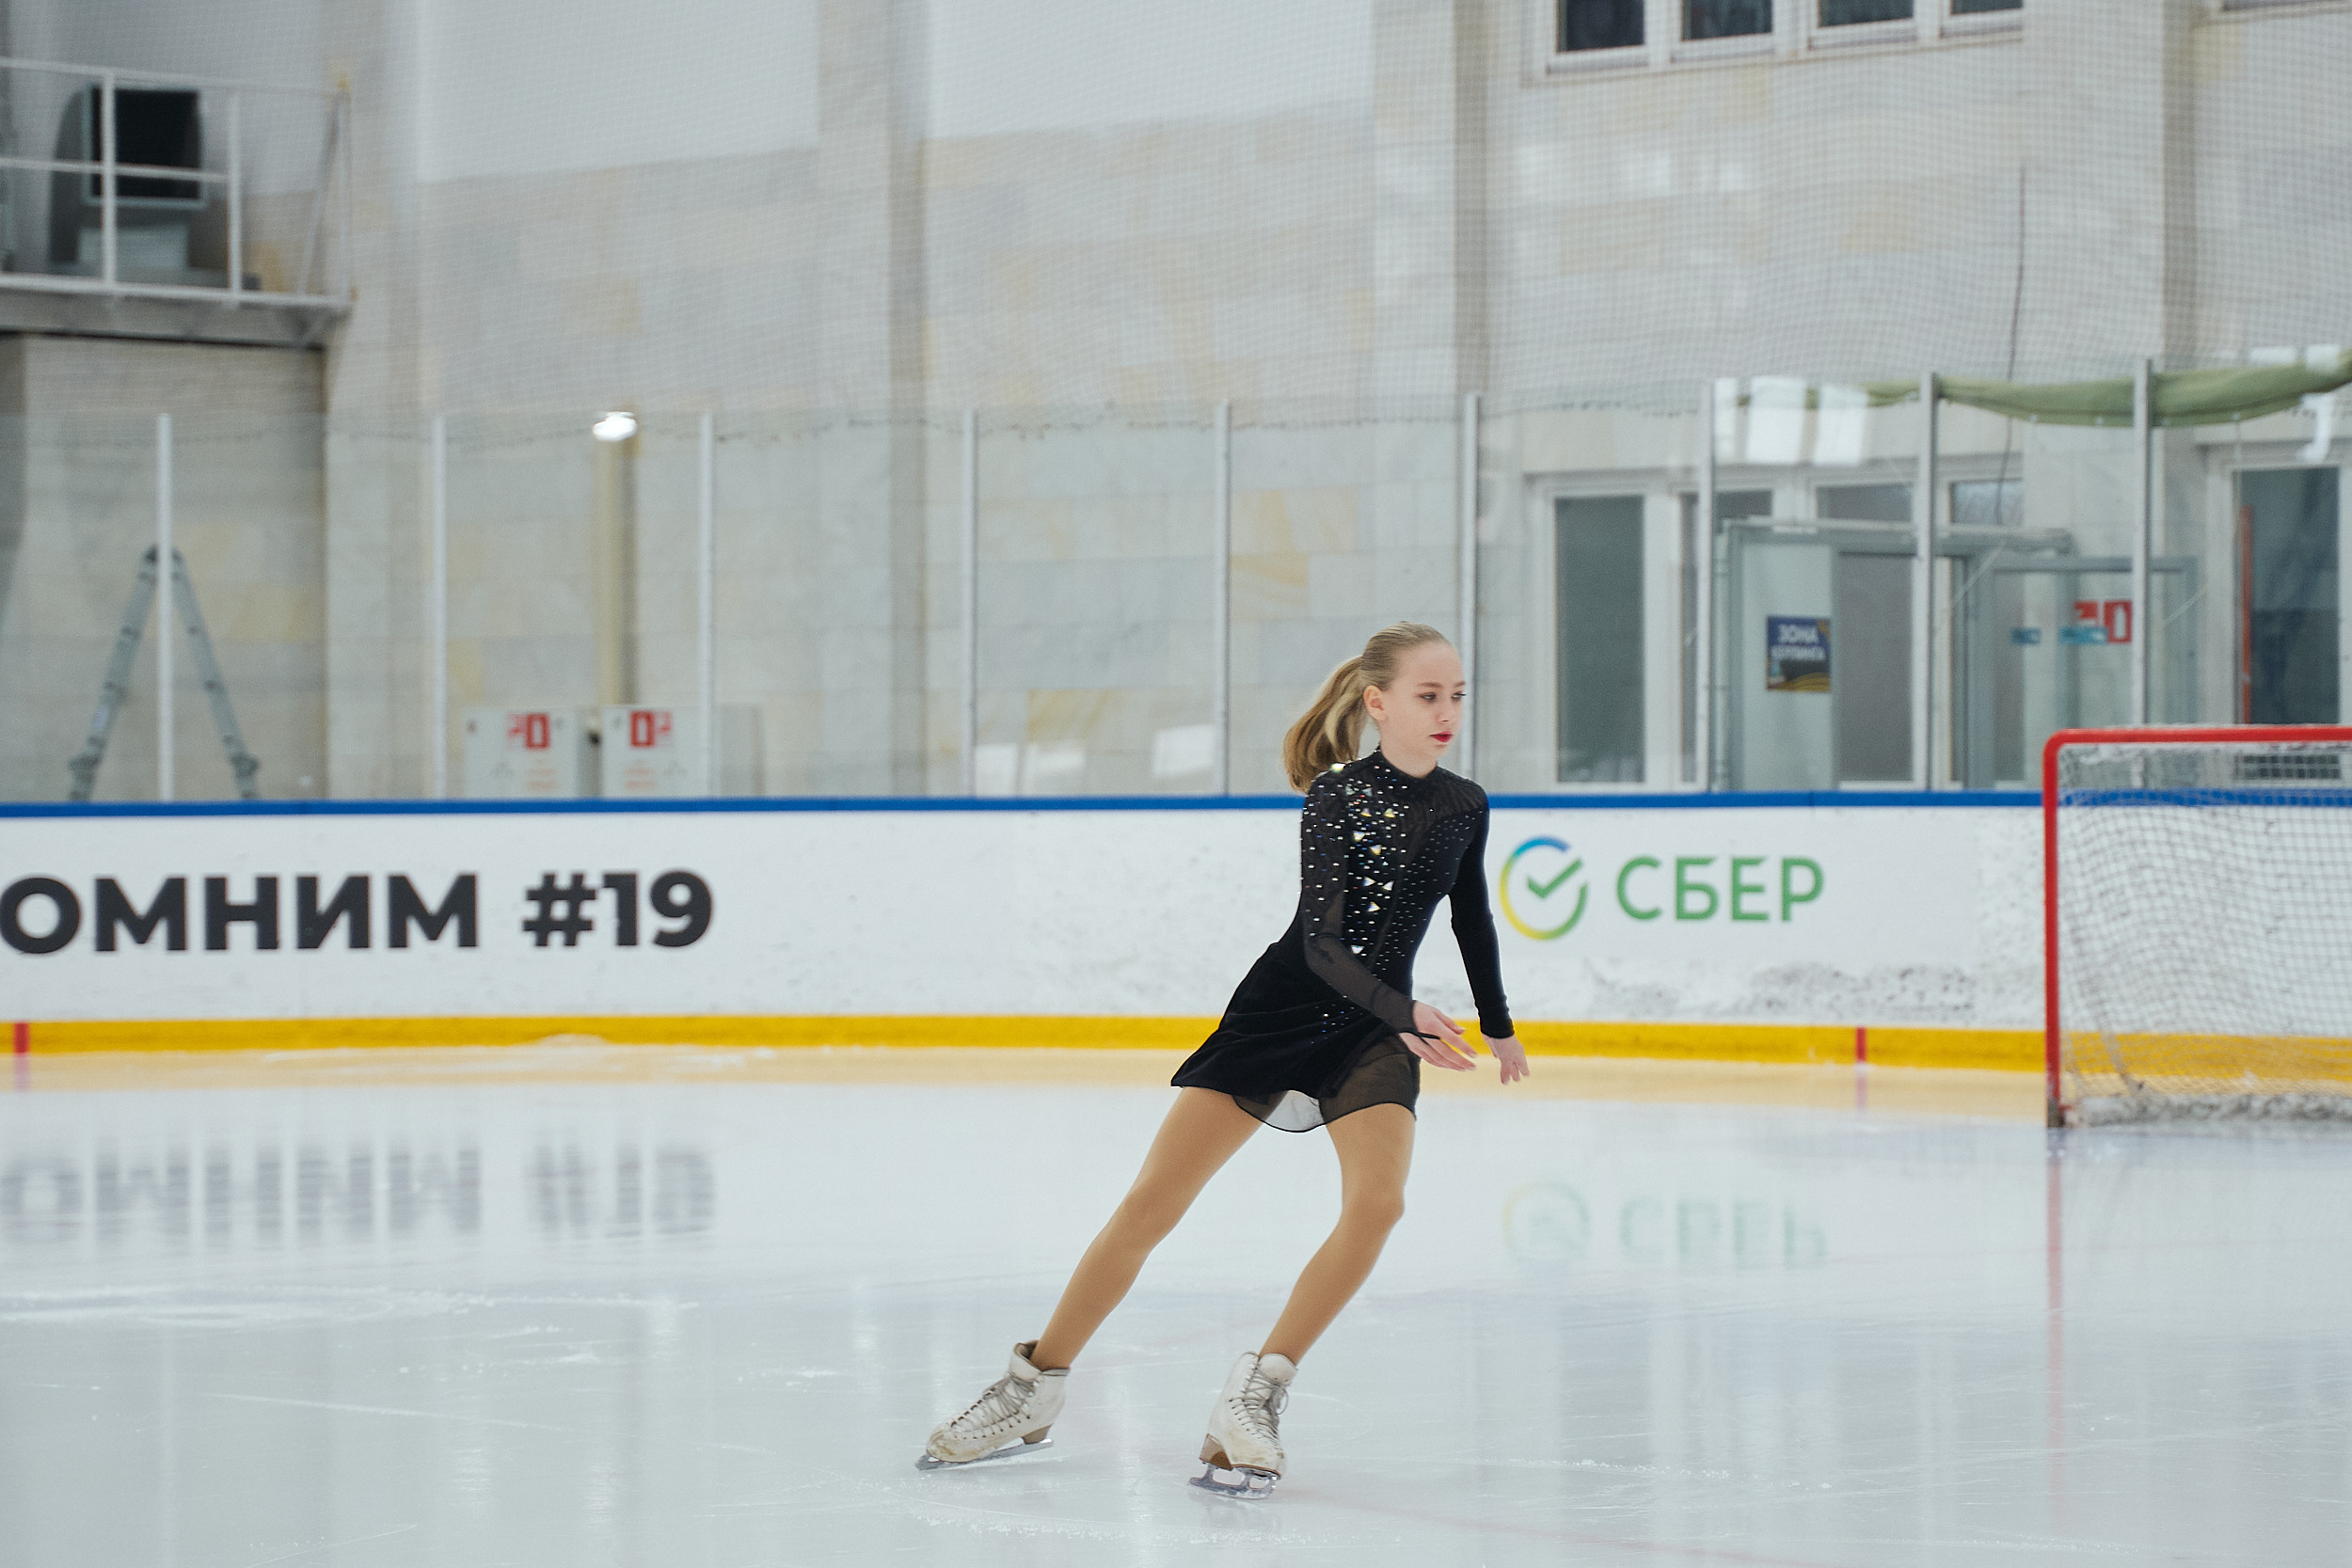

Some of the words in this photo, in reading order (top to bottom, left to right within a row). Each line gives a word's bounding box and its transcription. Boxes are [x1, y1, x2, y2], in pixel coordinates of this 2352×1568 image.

[0, 874, 478, 954] ОМНИМ
[522, 870, 712, 948] #19
[1615, 855, 1824, 922] СБЕР
